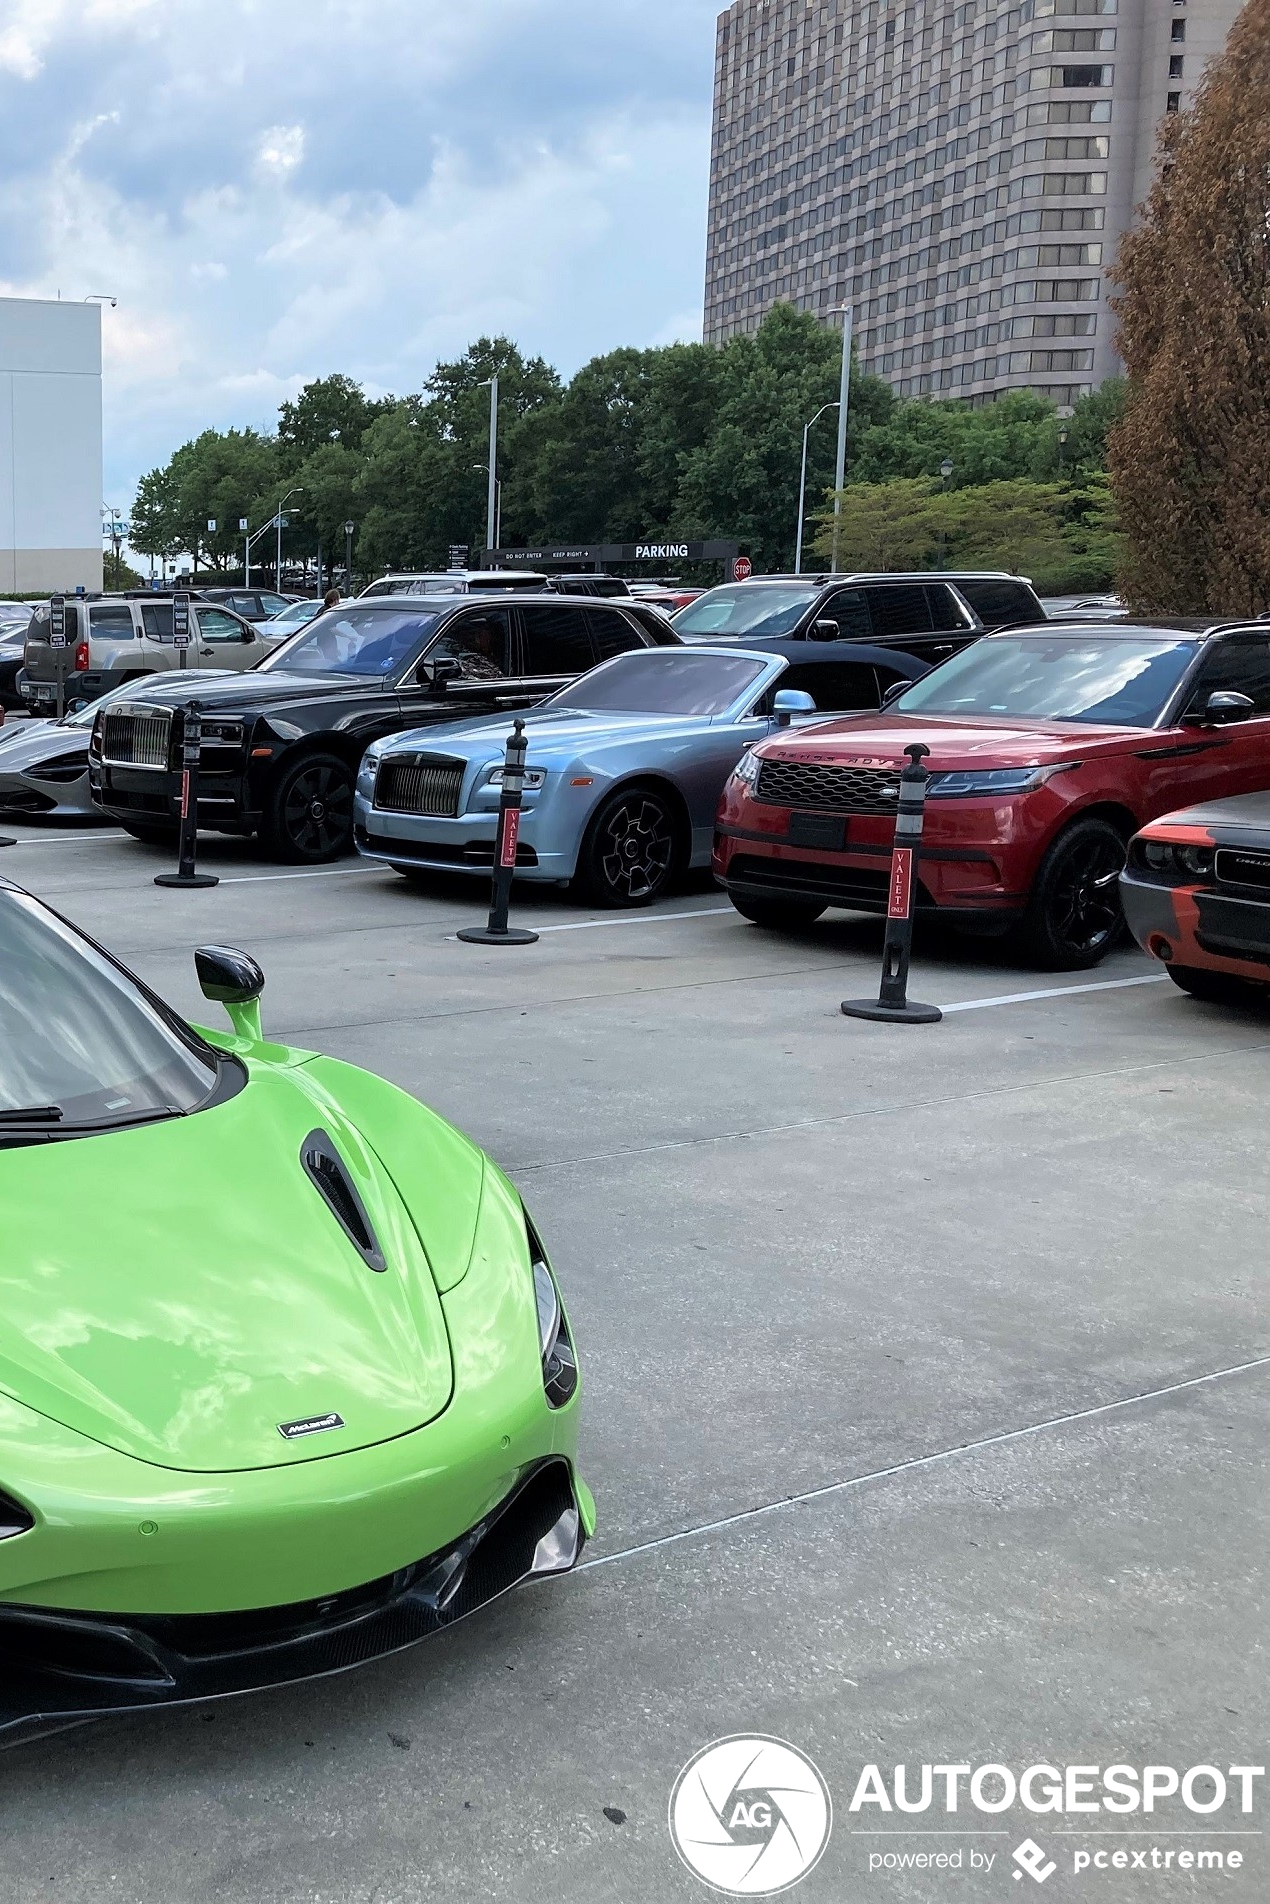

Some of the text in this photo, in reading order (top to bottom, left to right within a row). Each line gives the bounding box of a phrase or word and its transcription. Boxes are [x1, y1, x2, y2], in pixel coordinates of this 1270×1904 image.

[635, 544, 688, 558] PARKING
[735, 564, 750, 574] STOP
[508, 812, 517, 856] VALET
[894, 853, 904, 905] VALET
